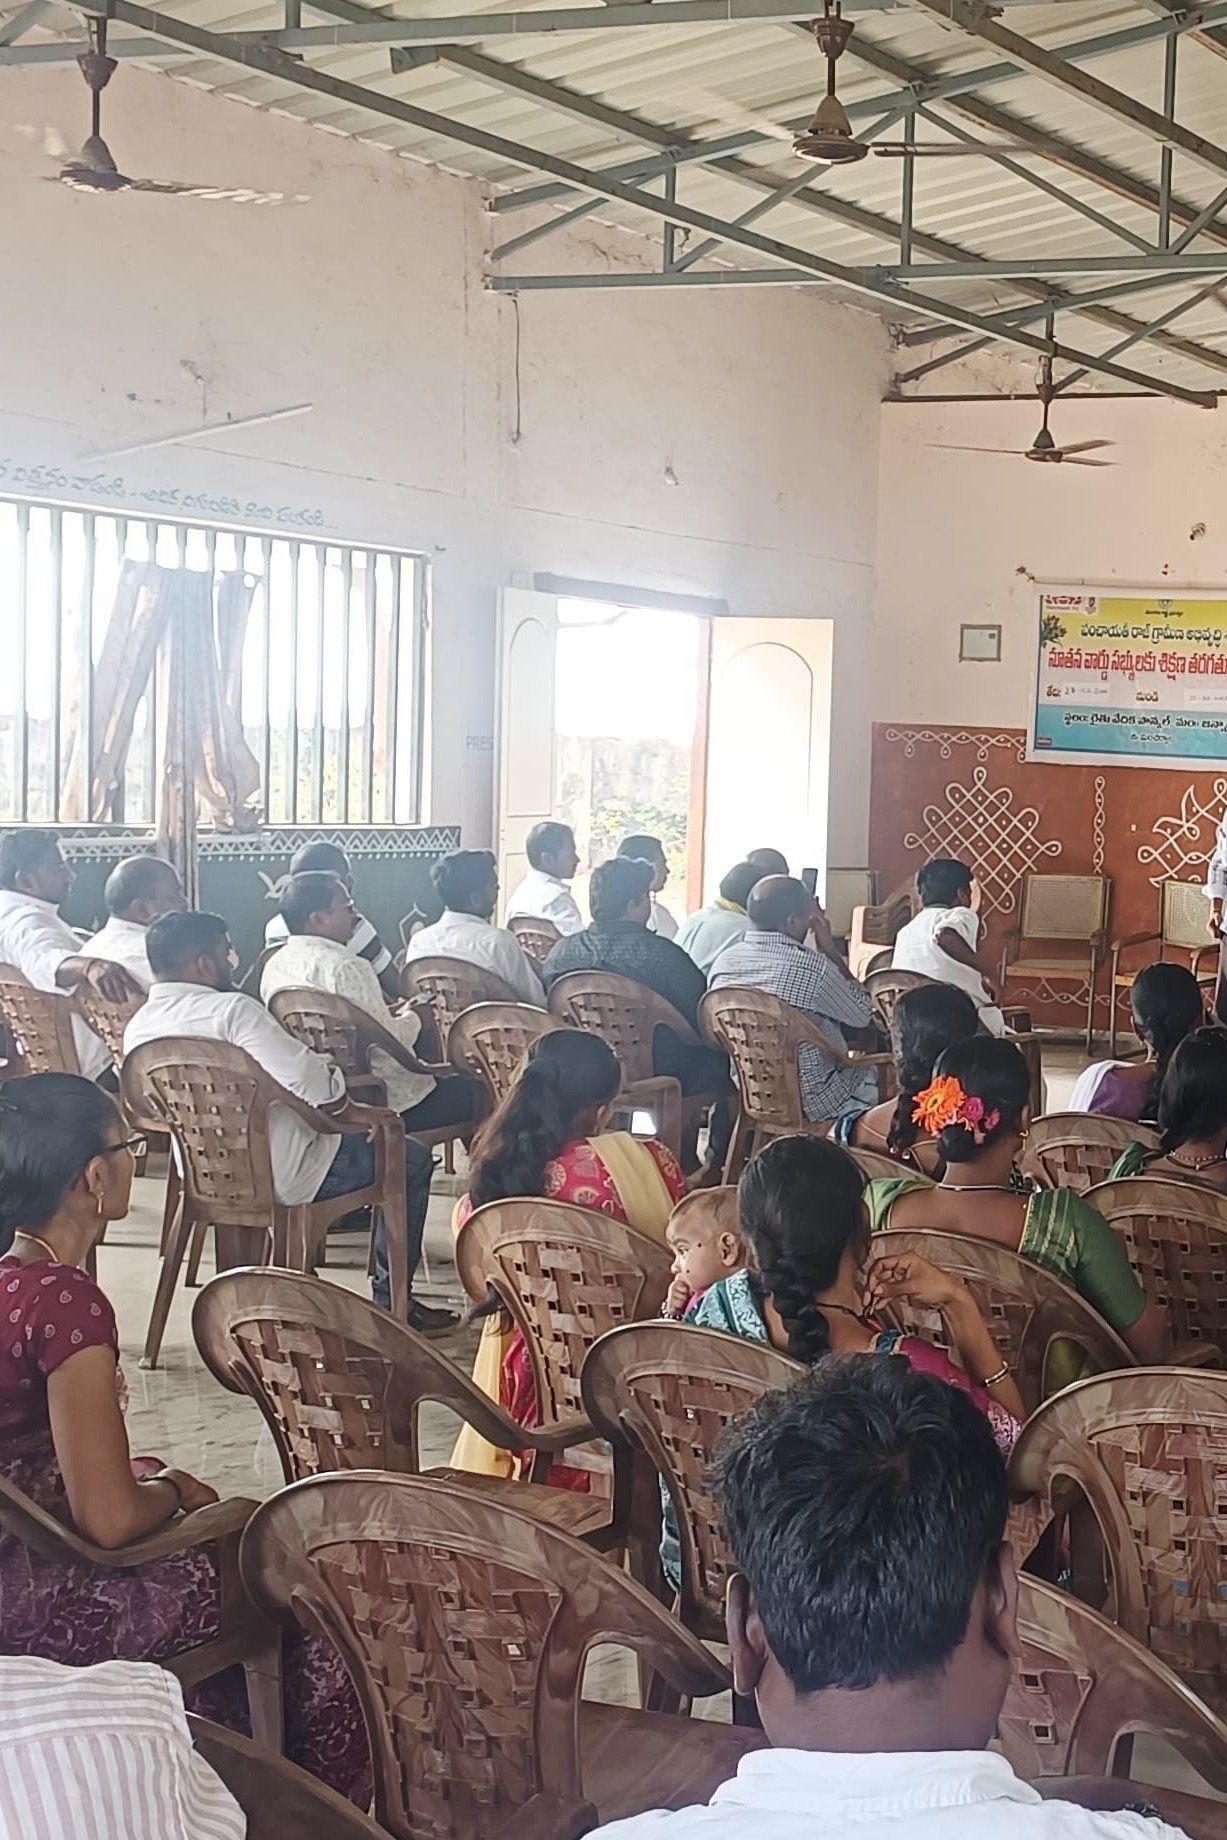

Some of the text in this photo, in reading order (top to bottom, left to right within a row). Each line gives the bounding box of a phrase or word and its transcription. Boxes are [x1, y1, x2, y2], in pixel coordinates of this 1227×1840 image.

[1131, 623, 1151, 639] రాజ్
[1048, 647, 1082, 668] నూతన
[1084, 649, 1109, 680] వార్డు
[1111, 649, 1156, 681] సభ్యులకు
[1158, 652, 1186, 681] శిక్షణ
